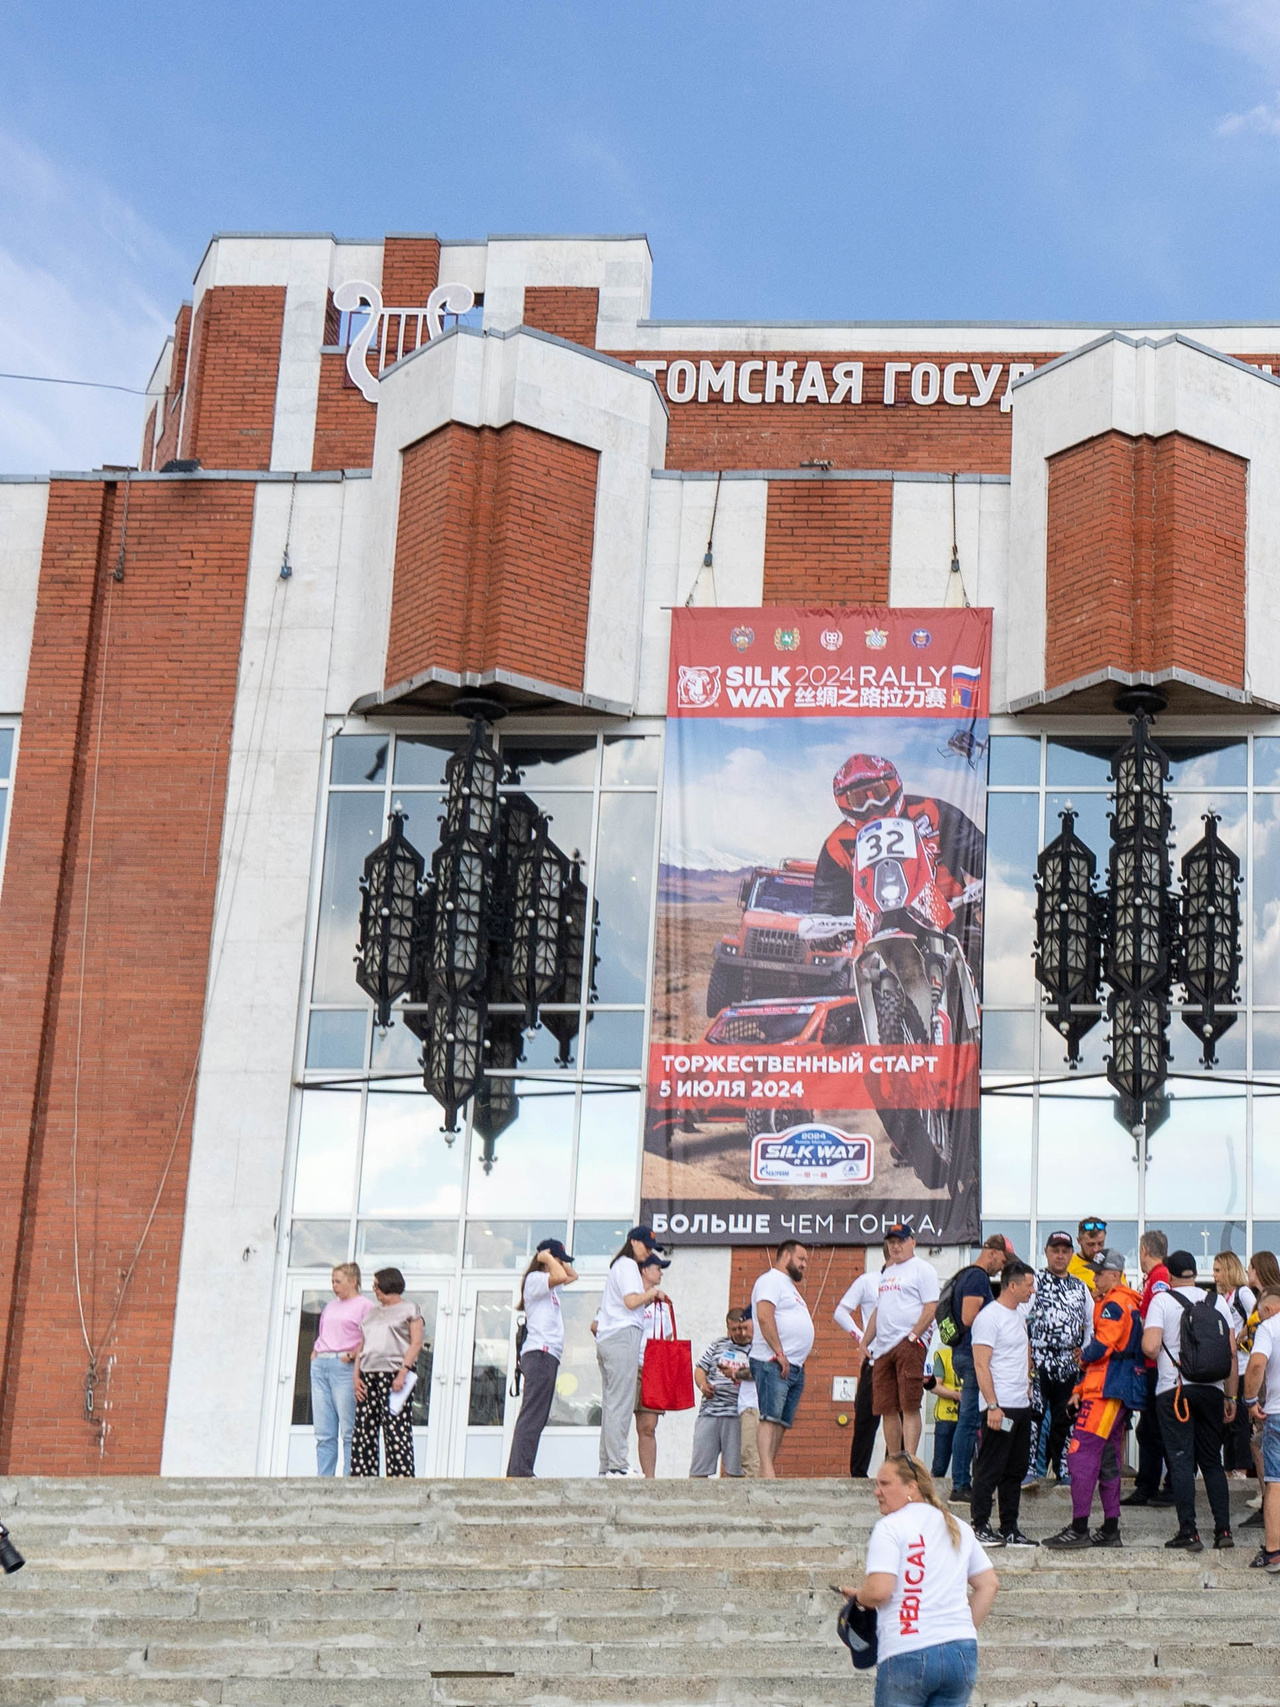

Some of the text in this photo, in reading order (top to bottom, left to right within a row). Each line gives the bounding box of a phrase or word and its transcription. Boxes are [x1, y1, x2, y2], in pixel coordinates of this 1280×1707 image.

[726, 665, 947, 687] SILK 2024 RALLY
[726, 688, 791, 708] WAY
[794, 687, 947, 709] 丝绸之路拉力赛
[865, 830, 905, 862] 32
[662, 1052, 938, 1074] ТОРЖЕСТВЕННЫЙ СТАРТ
[660, 1080, 804, 1098] 5 ИЮЛЯ 2024
[765, 1145, 860, 1158] SILK WAY
[653, 1214, 943, 1237] БОЛЬШЕ ЧЕМ ГОНКА,
[900, 1534, 927, 1636] MEDICAL
